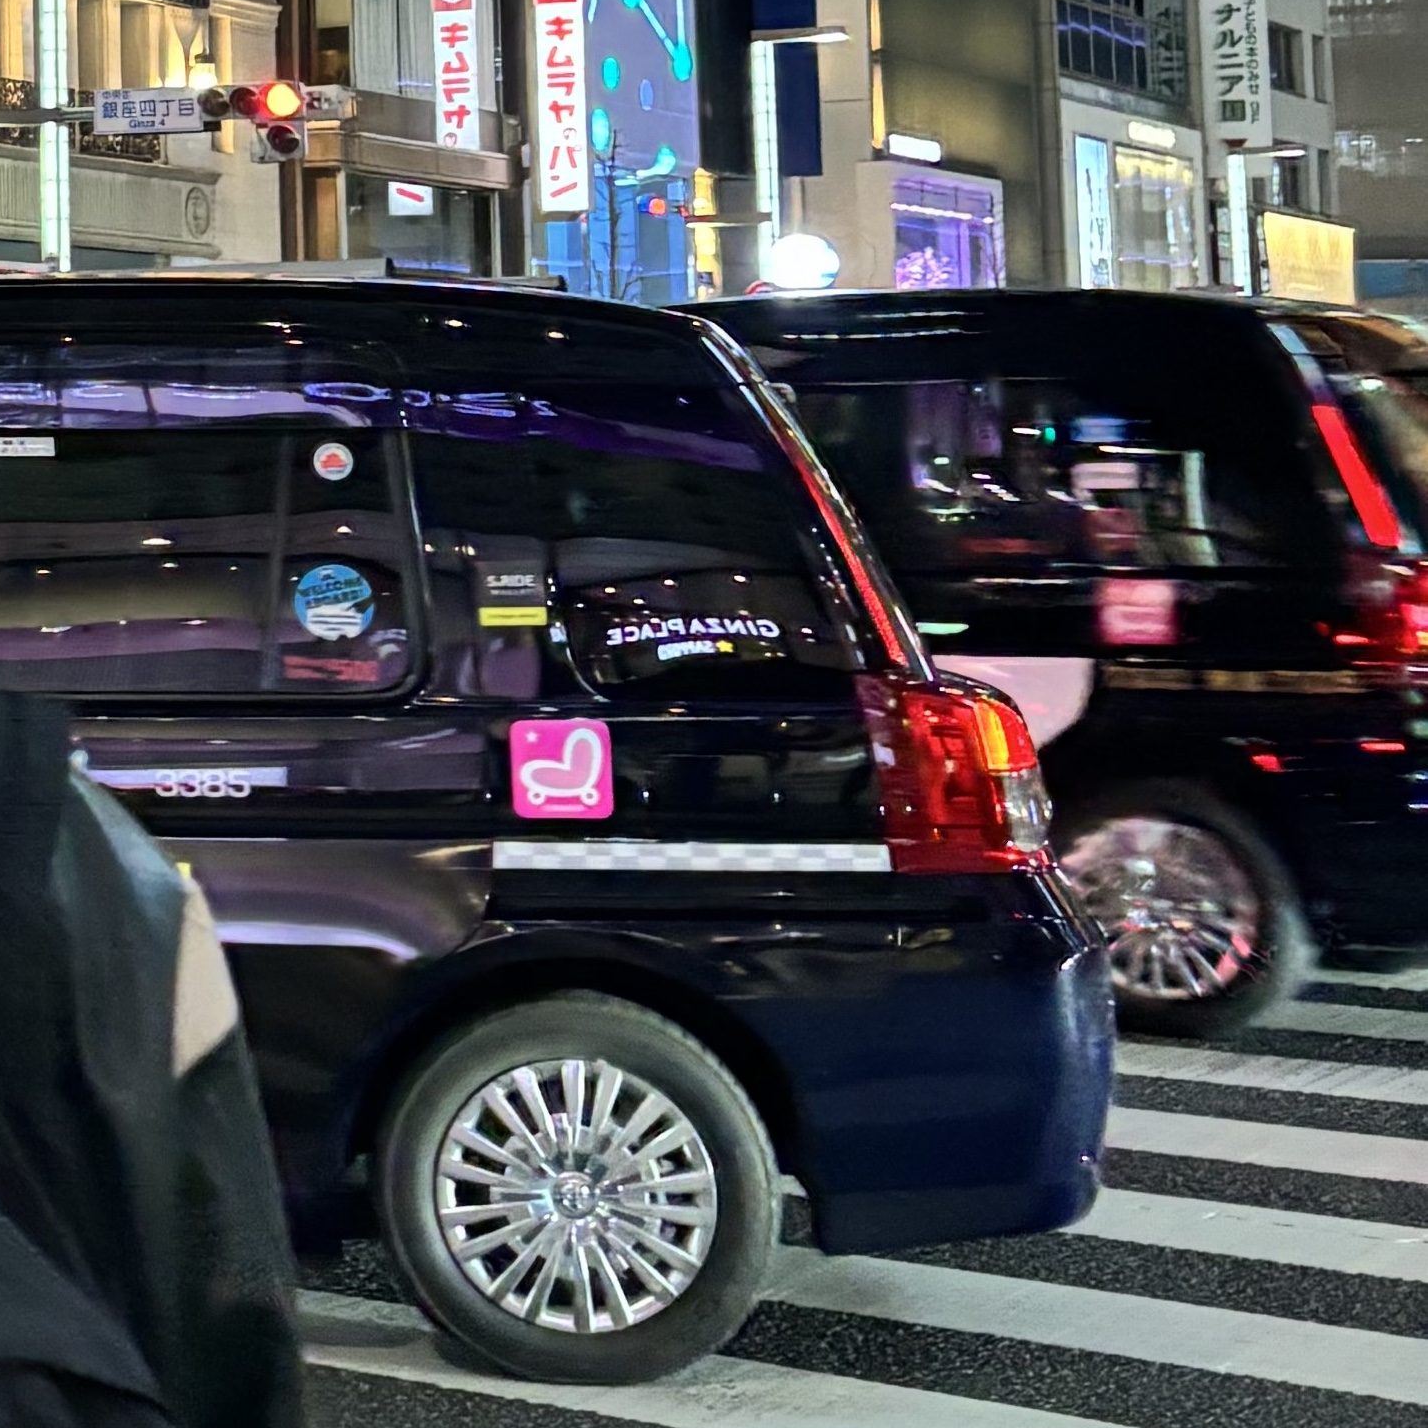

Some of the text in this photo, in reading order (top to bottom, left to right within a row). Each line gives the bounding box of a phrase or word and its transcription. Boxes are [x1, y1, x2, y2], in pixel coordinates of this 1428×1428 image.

[102, 98, 195, 119] 銀座四丁目
[545, 16, 582, 199] キムラヤのパン
[129, 118, 166, 128] Ginza 4
[155, 769, 251, 798] 3385
